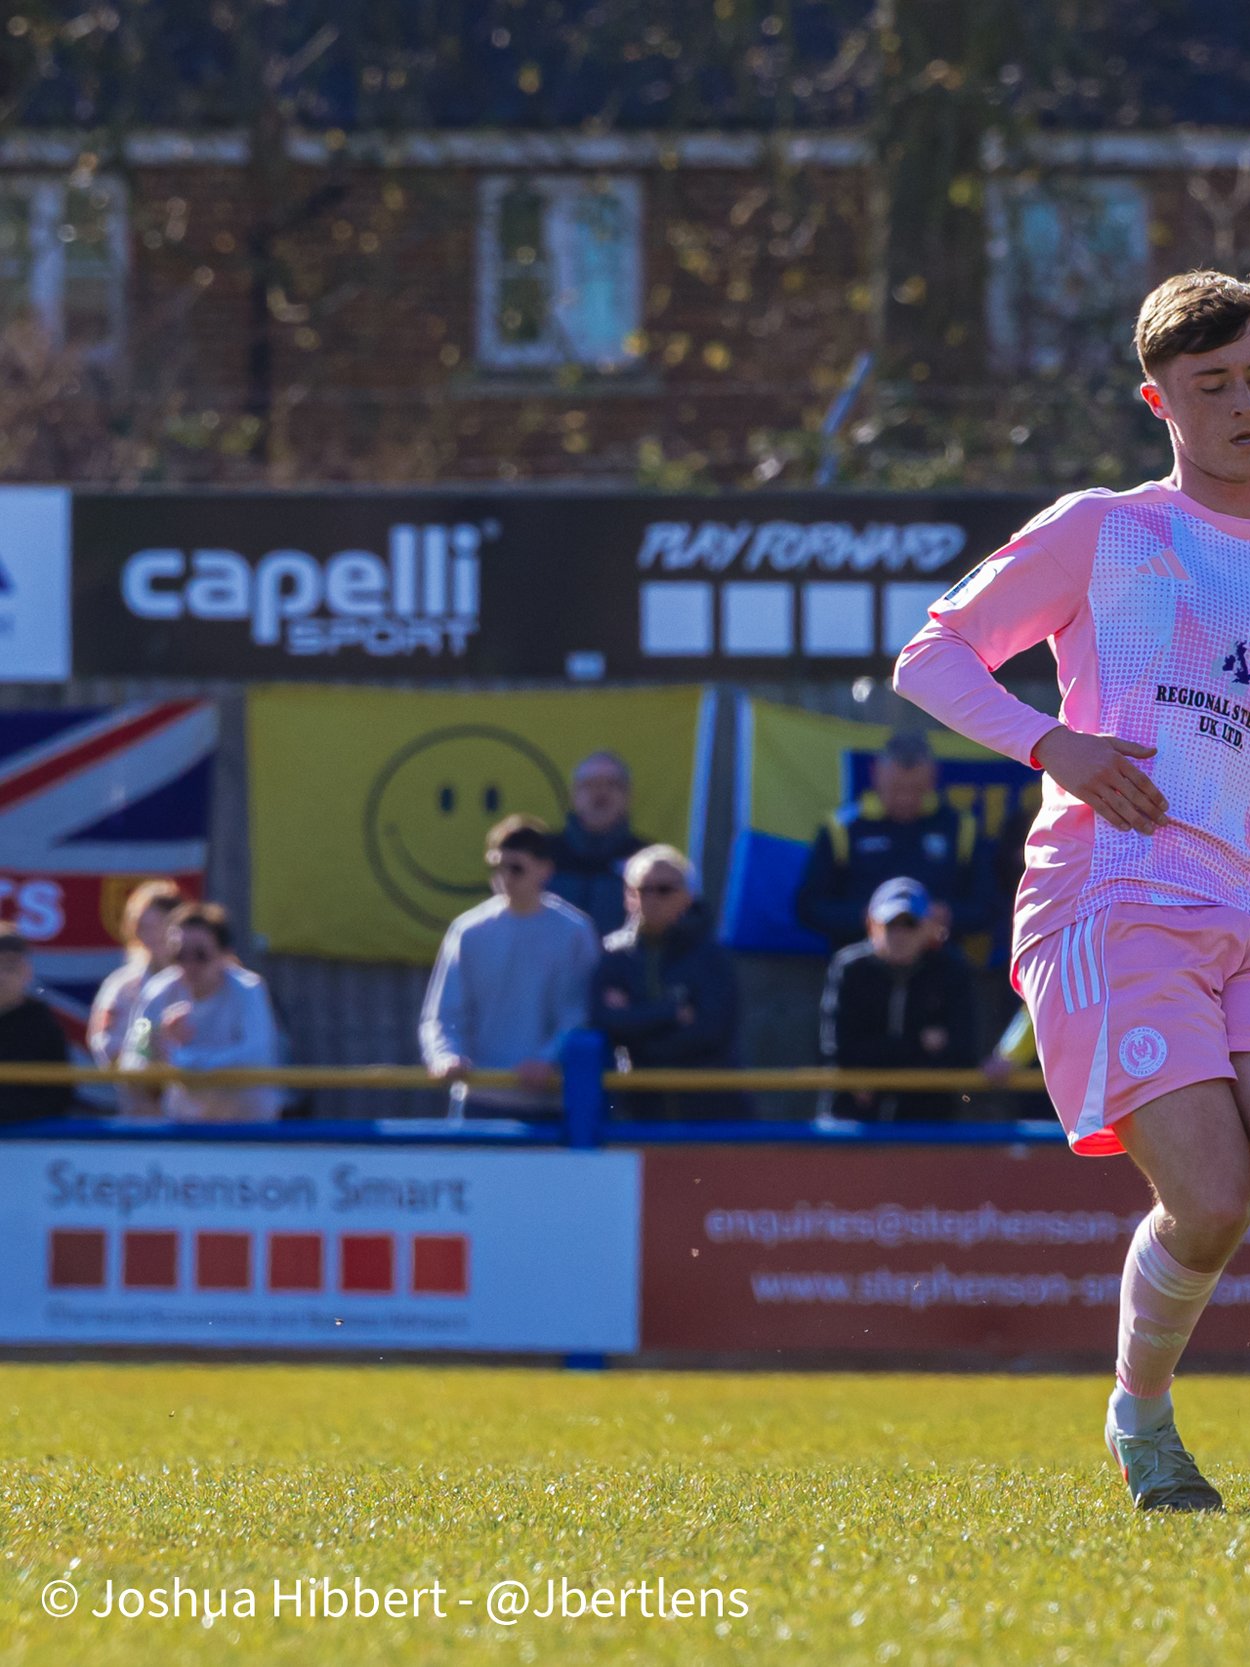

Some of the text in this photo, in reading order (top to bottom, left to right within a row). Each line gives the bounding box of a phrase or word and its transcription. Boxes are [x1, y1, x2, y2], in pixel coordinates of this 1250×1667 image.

[637, 520, 967, 573] PLAY FORWARD
[121, 522, 481, 645] capelli
[287, 618, 480, 657] SPORT
[1155, 684, 1231, 717] REGIONAL
[1199, 715, 1243, 750] UK LTD.
[45, 1159, 472, 1218] Stephenson Smart
